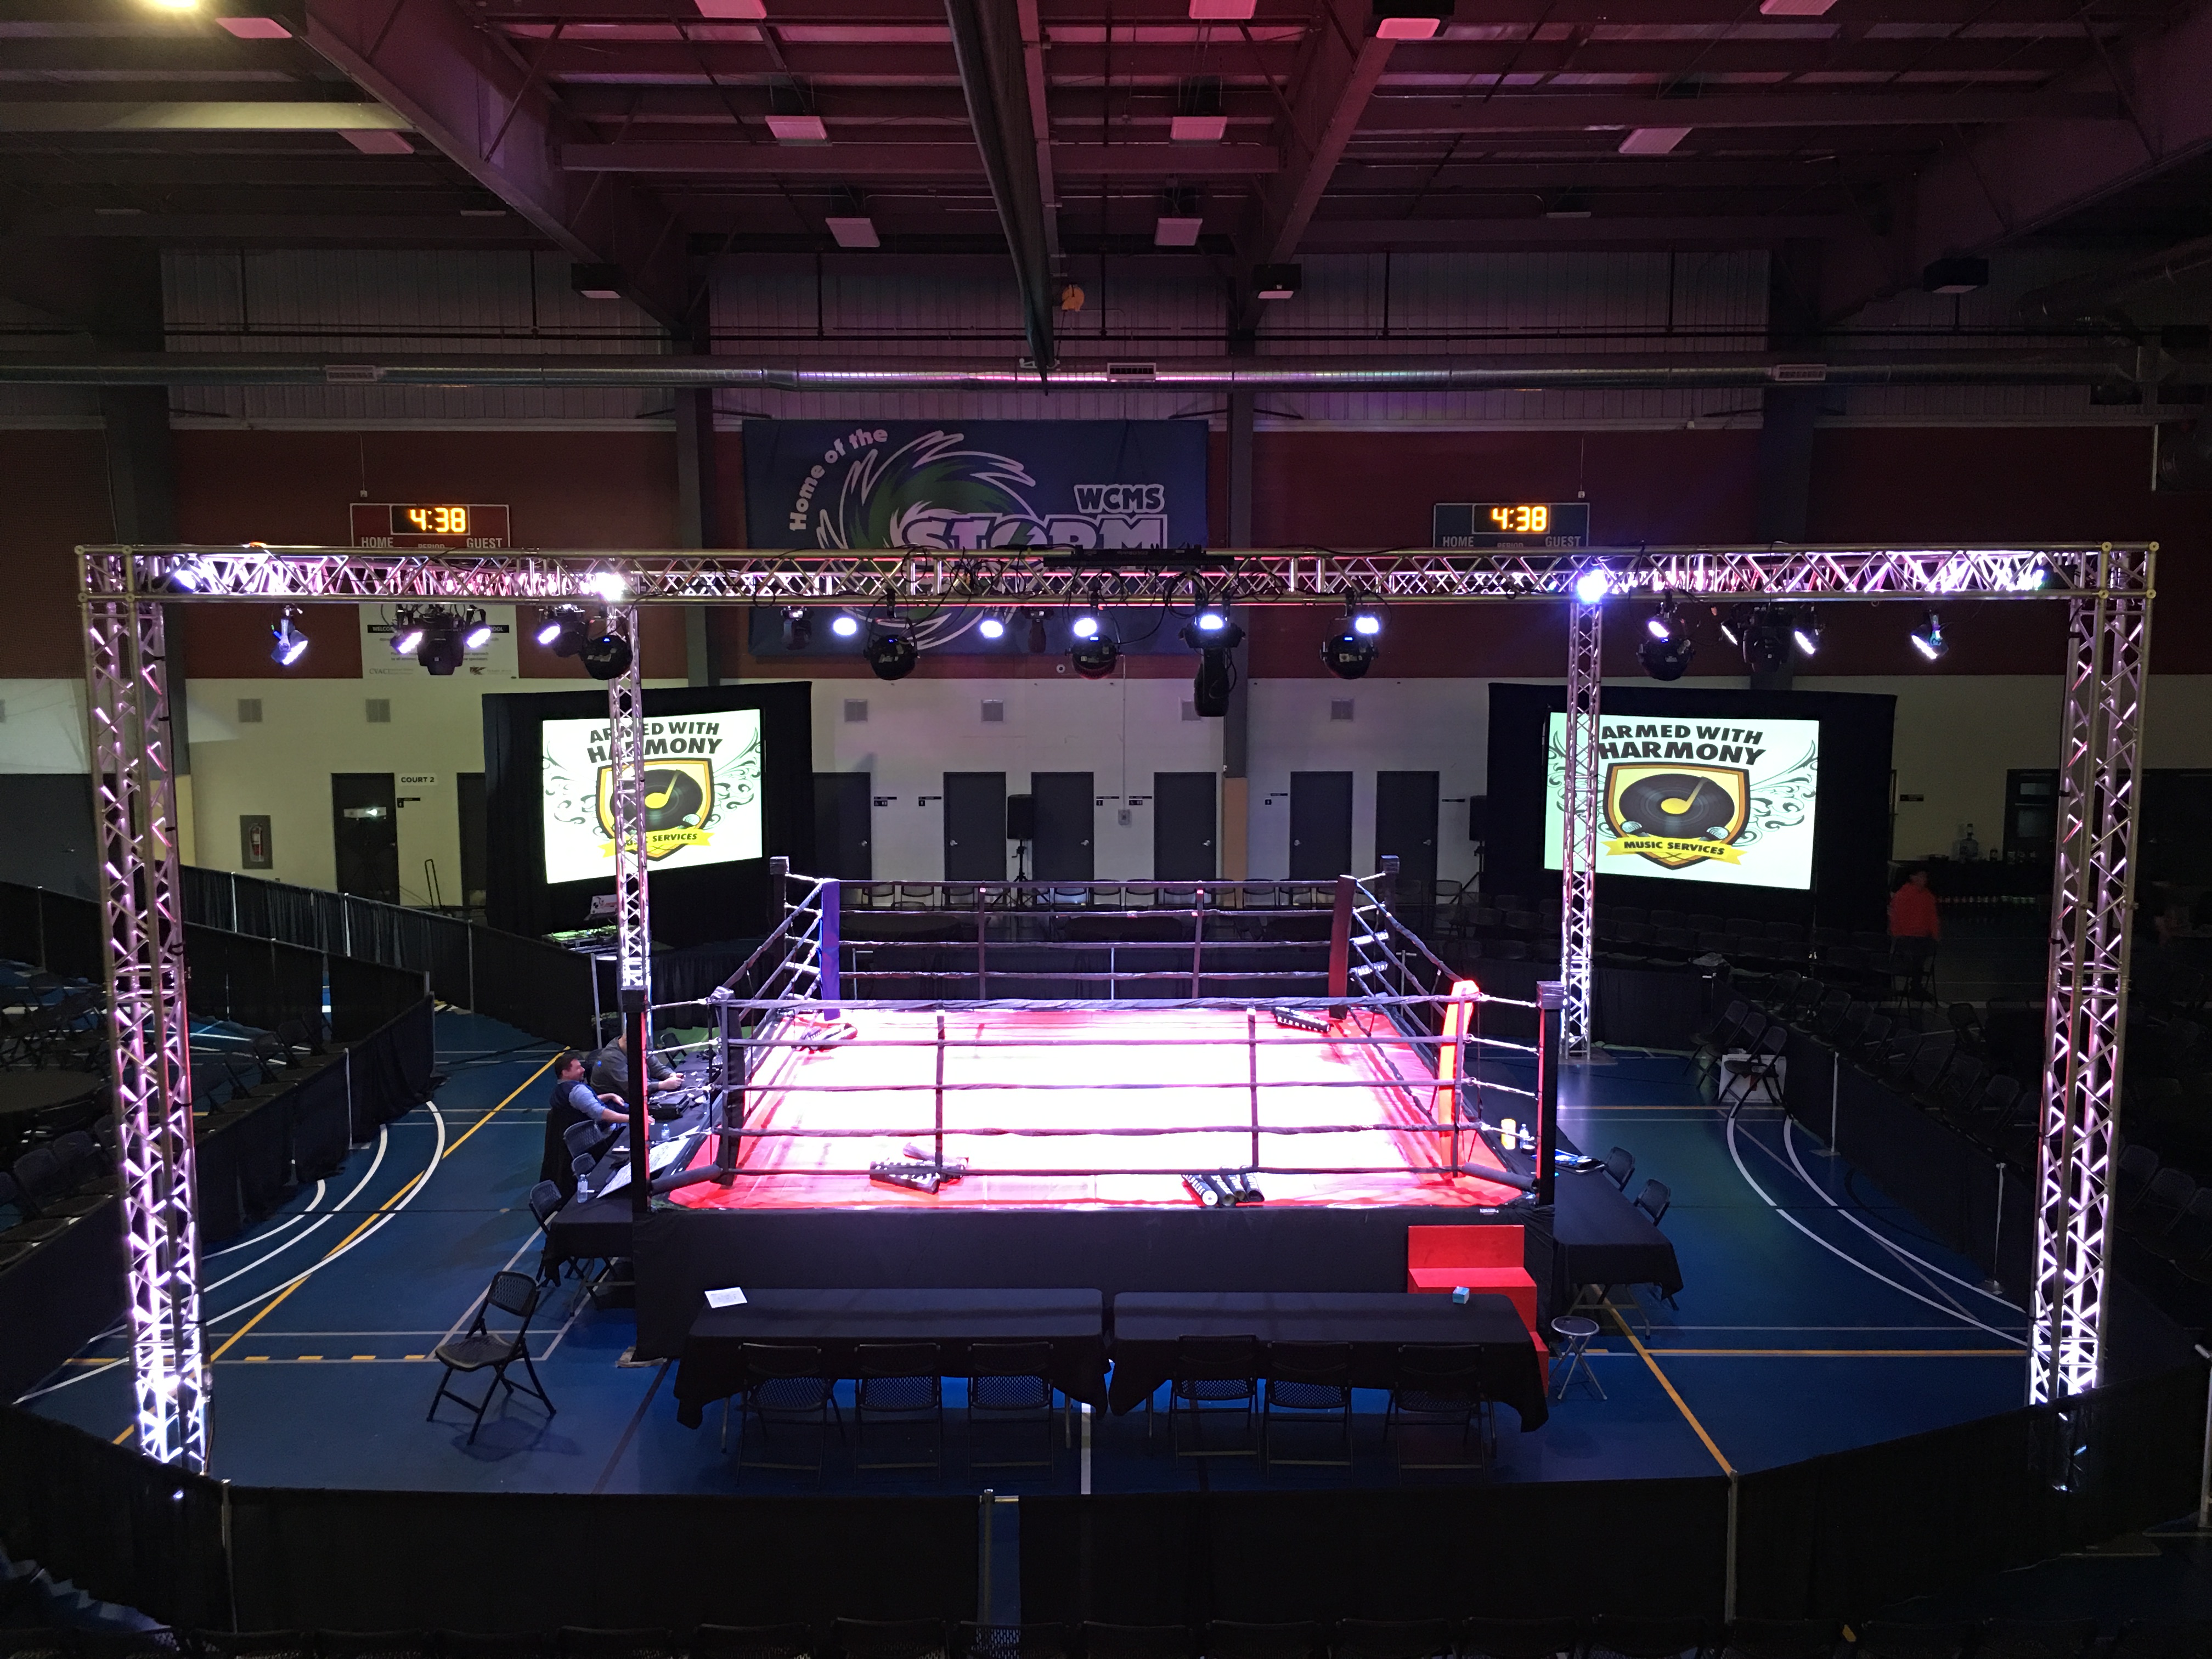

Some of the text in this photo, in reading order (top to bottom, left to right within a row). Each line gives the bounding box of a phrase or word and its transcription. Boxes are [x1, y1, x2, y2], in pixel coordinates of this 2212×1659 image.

[789, 428, 888, 531] Home of the
[1075, 485, 1163, 512] WCMS
[409, 507, 466, 532] 4:38
[1492, 506, 1547, 531] 4:38
[361, 537, 503, 548] HOME GUEST
[1442, 535, 1581, 547] HOME GUEST
[668, 721, 720, 735] WITH
[1601, 724, 1763, 745] ARMED WITH
[1598, 741, 1766, 765] HARMONY
[652, 833, 697, 842] SERVICES
[1667, 842, 1725, 855] SERVICES
